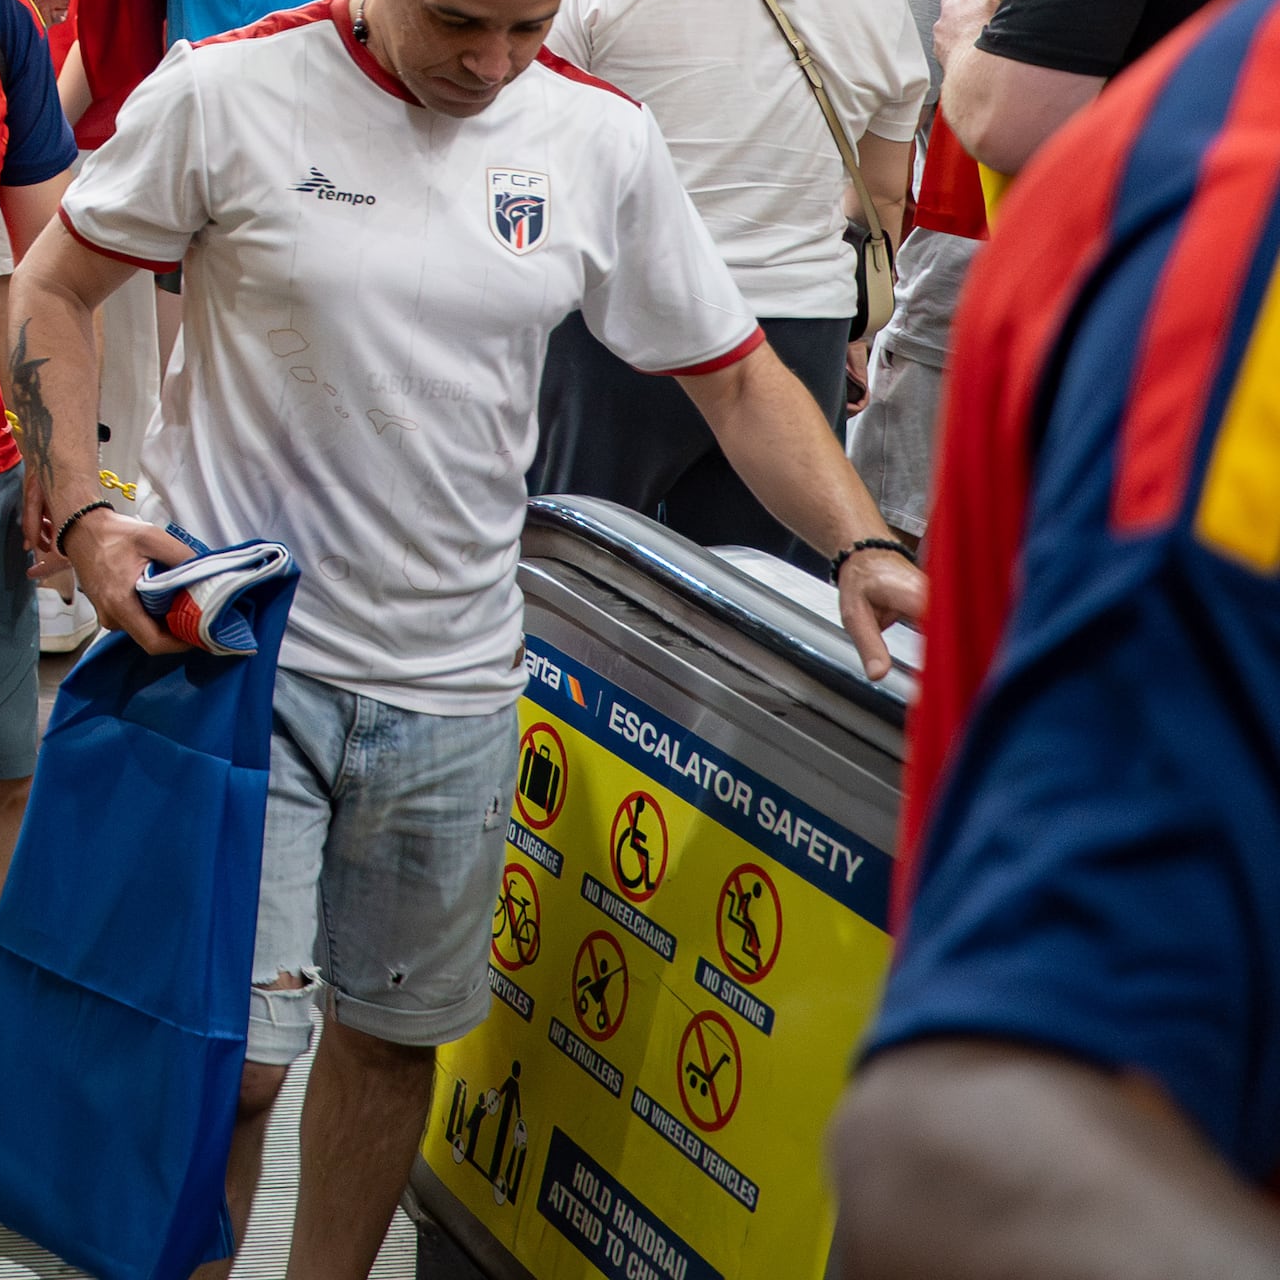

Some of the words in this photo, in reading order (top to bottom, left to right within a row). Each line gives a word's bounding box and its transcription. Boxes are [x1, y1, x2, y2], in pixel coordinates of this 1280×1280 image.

[317, 187, 377, 207] tempo
[492, 173, 543, 188] FCF
[366, 371, 412, 397] CABO
[417, 376, 474, 402] VERDE
[523, 648, 562, 690] arta
[608, 701, 752, 816] ESCALATOR
[757, 796, 864, 884] SAFETY
[516, 830, 560, 872] LUGGAGE
[585, 878, 601, 904] NO
[601, 890, 674, 958] WHEELCHAIRS
[488, 968, 531, 1016] BICYCLES
[702, 966, 720, 993] NO
[720, 979, 767, 1028] SITTING
[551, 1022, 566, 1047] NO
[565, 1034, 622, 1094] STROLLERS
[634, 1090, 650, 1117] NO
[650, 1103, 702, 1161] WHEELED
[702, 1146, 758, 1207] VEHICLES
[571, 1161, 613, 1216] HOLD
[547, 1180, 603, 1247] ATTEND
[605, 1228, 625, 1267] TO
